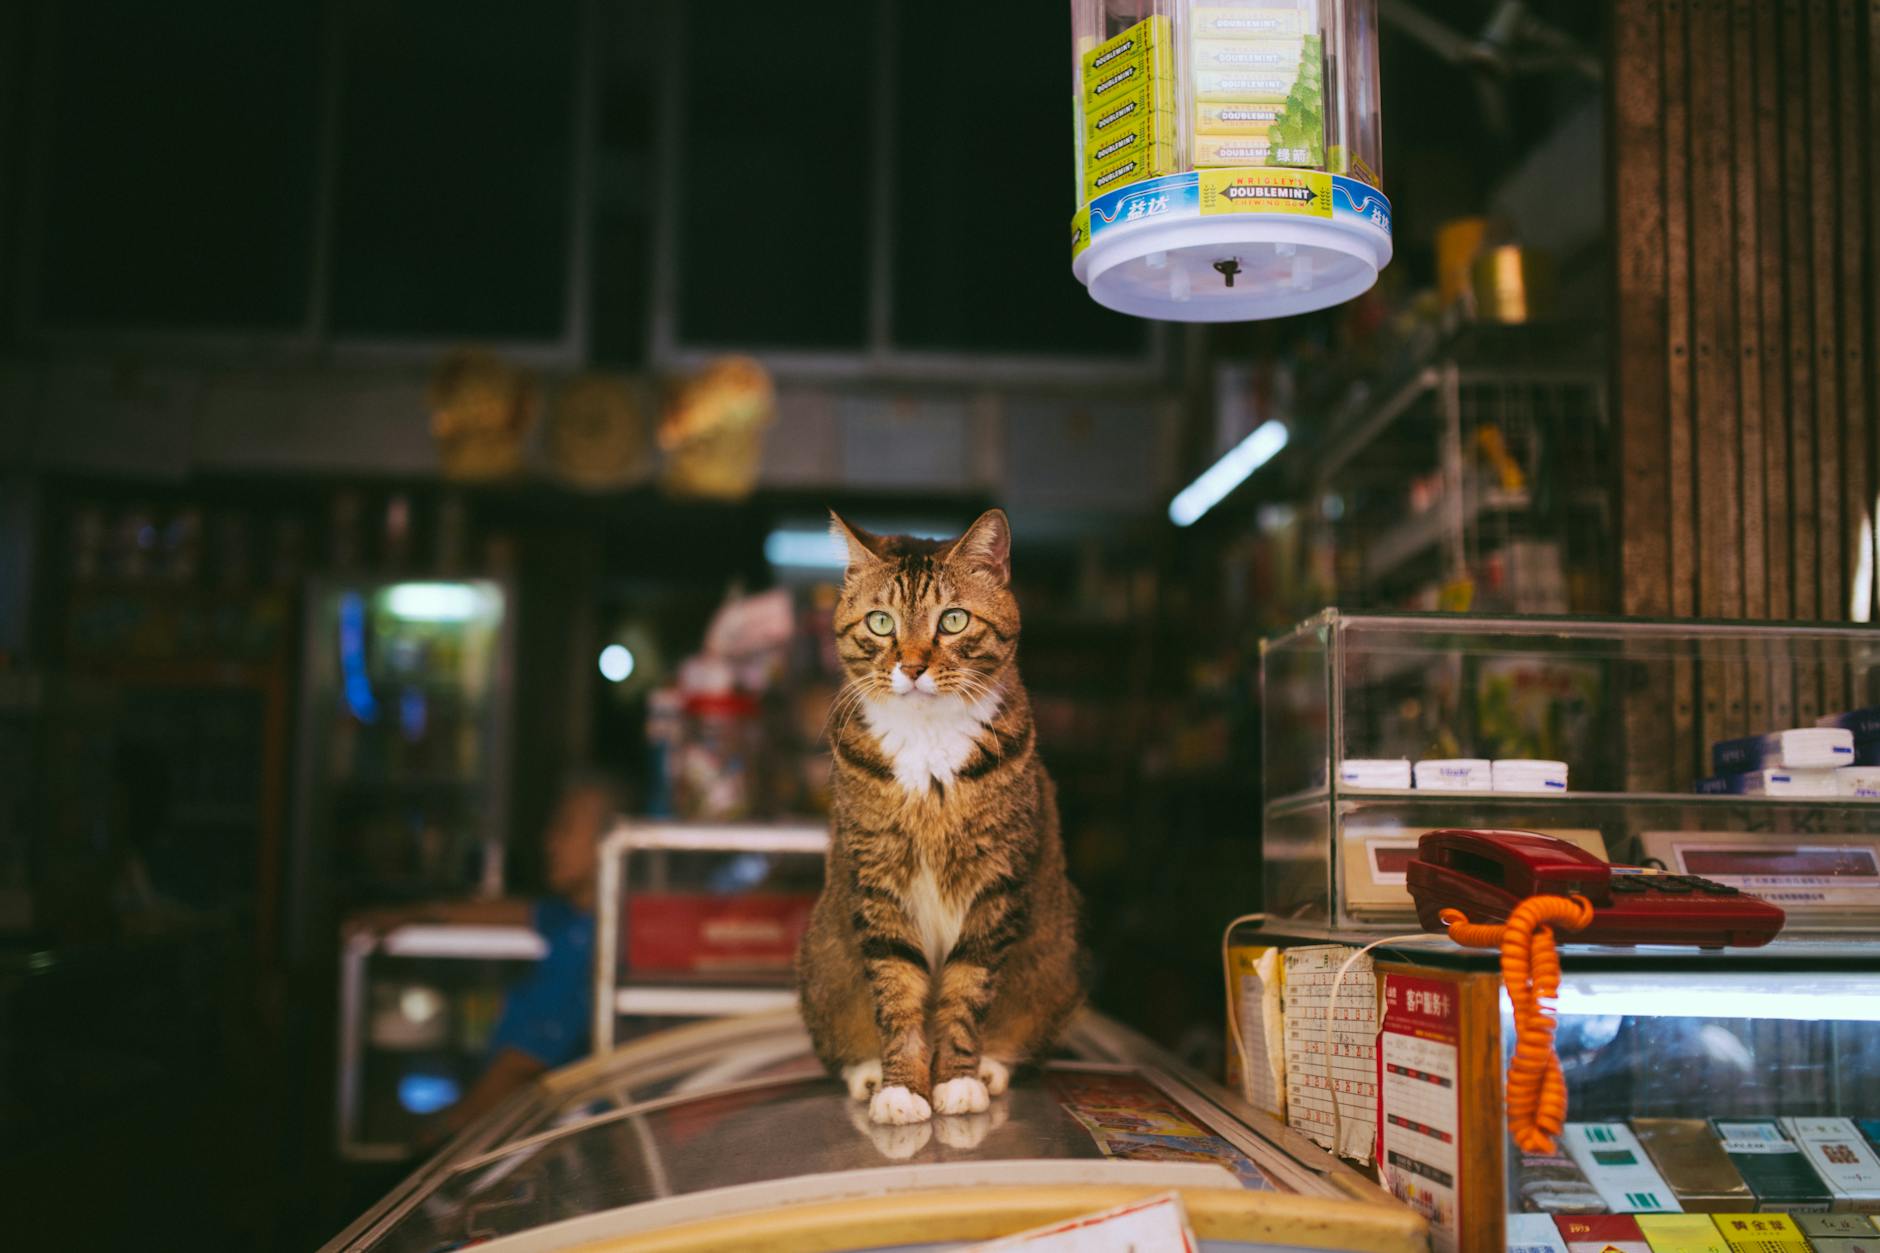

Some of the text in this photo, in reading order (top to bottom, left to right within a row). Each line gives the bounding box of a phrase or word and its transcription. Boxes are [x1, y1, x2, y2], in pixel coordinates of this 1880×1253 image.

[1236, 177, 1303, 187] WRIGLEY'S
[1229, 187, 1309, 199] DOUBLEMINT
[1126, 196, 1169, 222] 益达
[1406, 989, 1451, 1018] 客户服务卡
